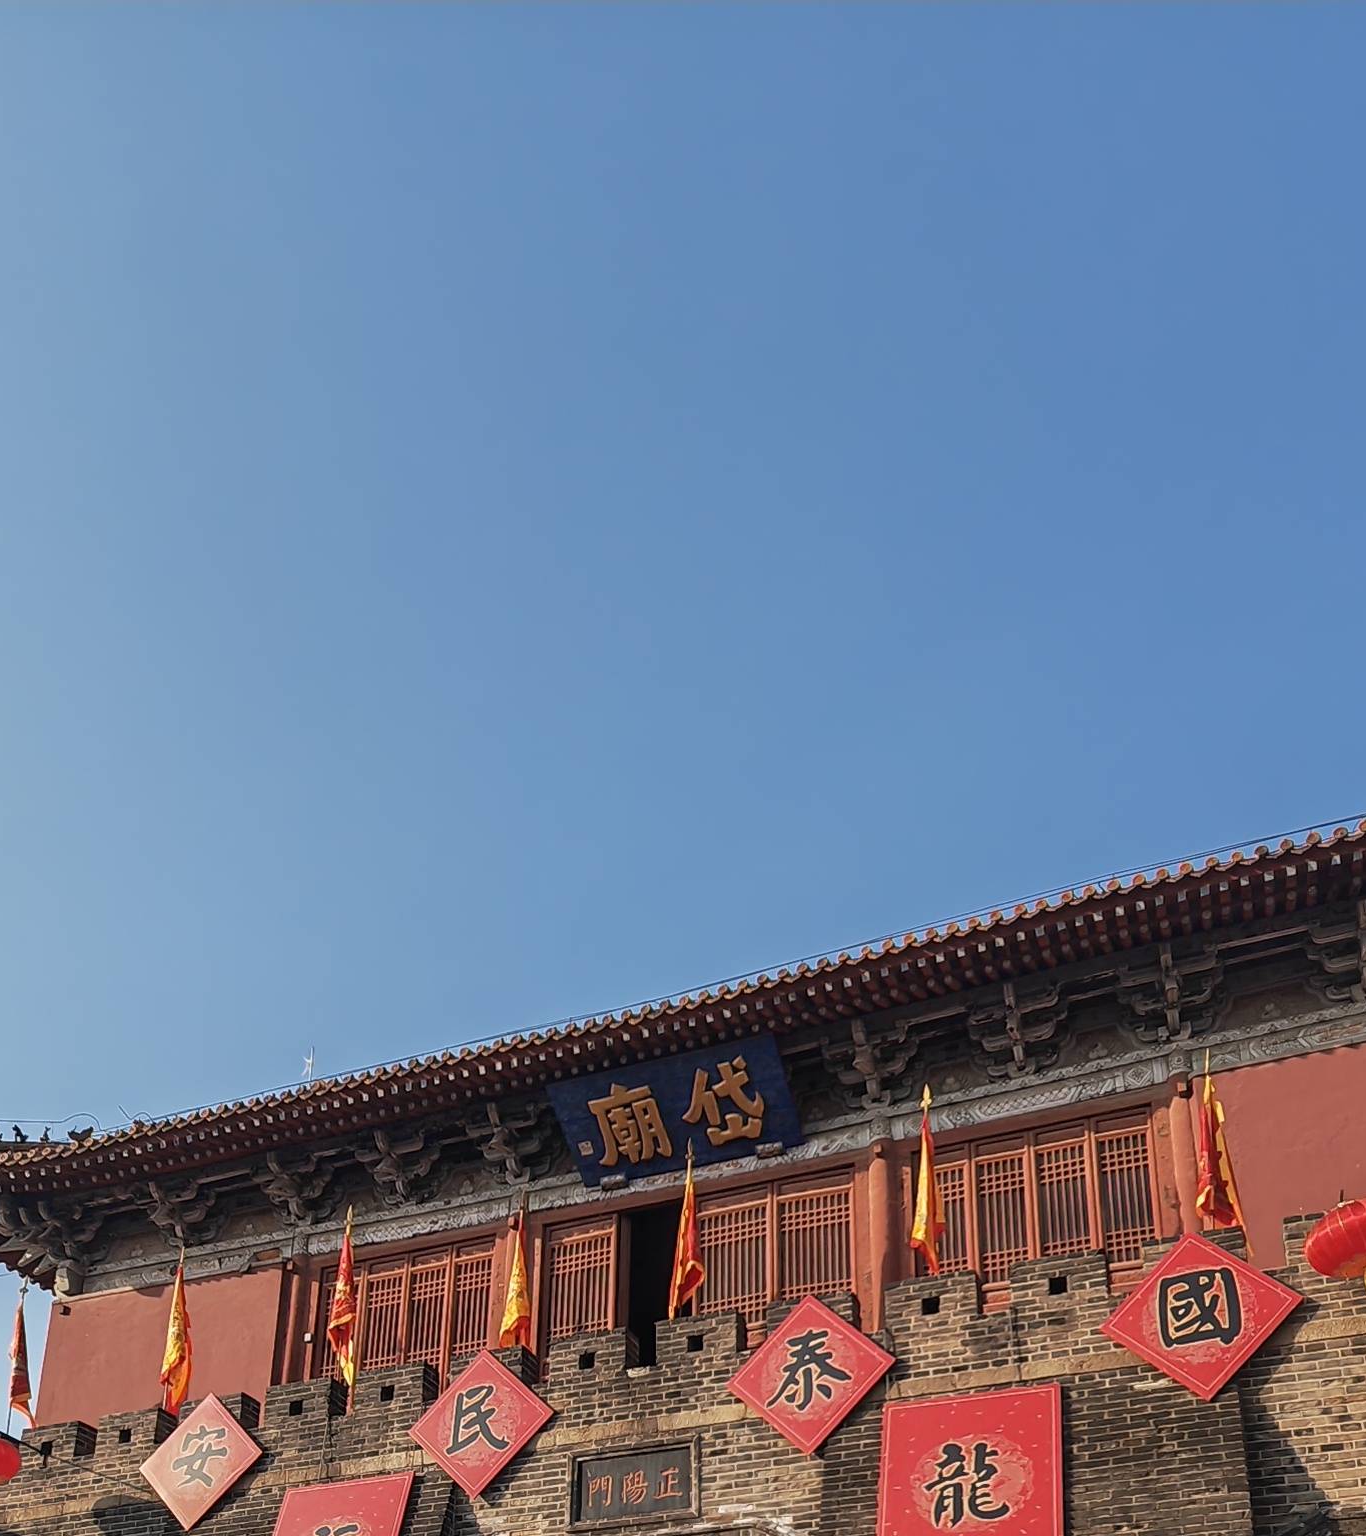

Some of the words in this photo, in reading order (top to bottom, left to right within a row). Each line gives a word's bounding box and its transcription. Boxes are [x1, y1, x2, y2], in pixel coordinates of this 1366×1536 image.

[1158, 1266, 1236, 1348] 國
[767, 1328, 852, 1412] 泰
[172, 1425, 229, 1489] 安
[445, 1384, 510, 1456] 民
